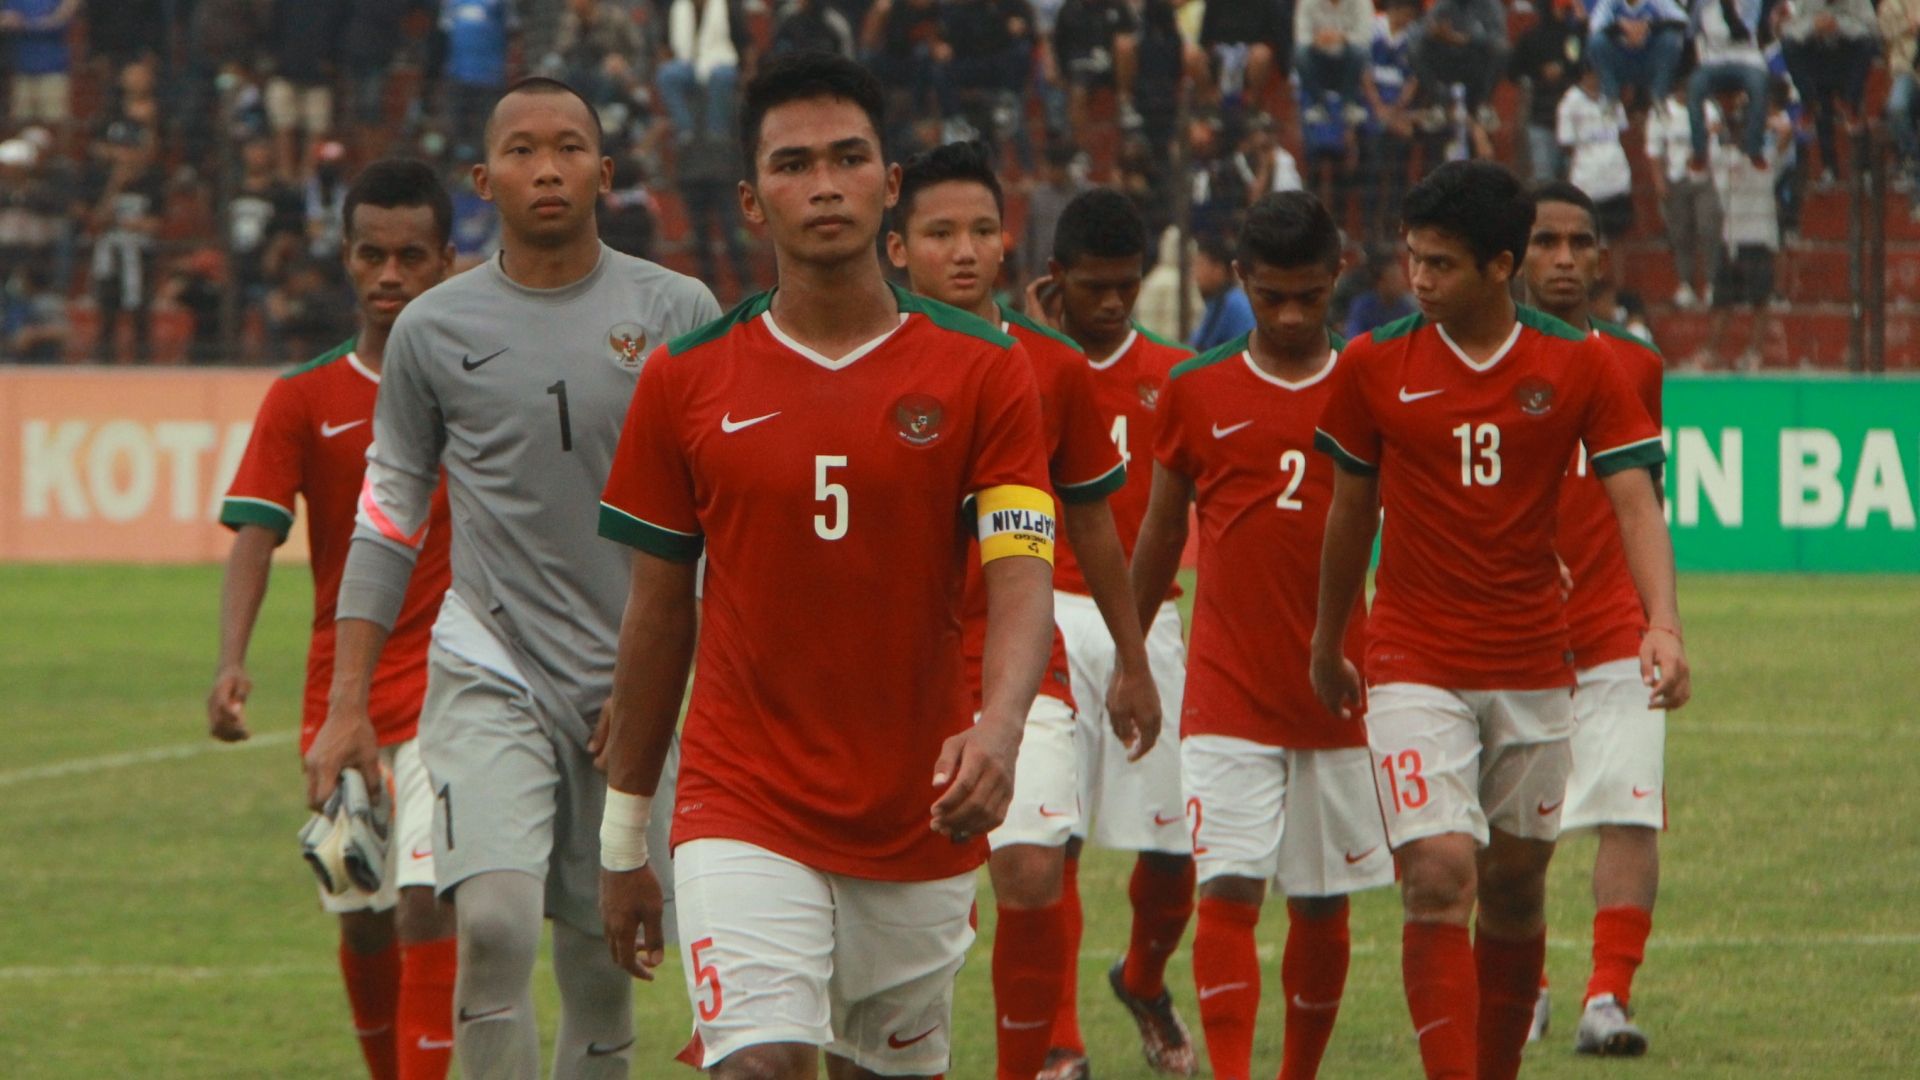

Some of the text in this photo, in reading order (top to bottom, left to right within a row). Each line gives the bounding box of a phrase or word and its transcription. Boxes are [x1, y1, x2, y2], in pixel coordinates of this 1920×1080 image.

[547, 380, 572, 451] 1
[1276, 450, 1306, 511] 2
[1452, 423, 1502, 487] 13
[1662, 427, 1916, 530] N BA
[814, 455, 849, 541] 5
[1381, 748, 1429, 814] 13
[437, 782, 455, 851] 1
[1186, 796, 1208, 855] 2
[691, 937, 722, 1022] 5
